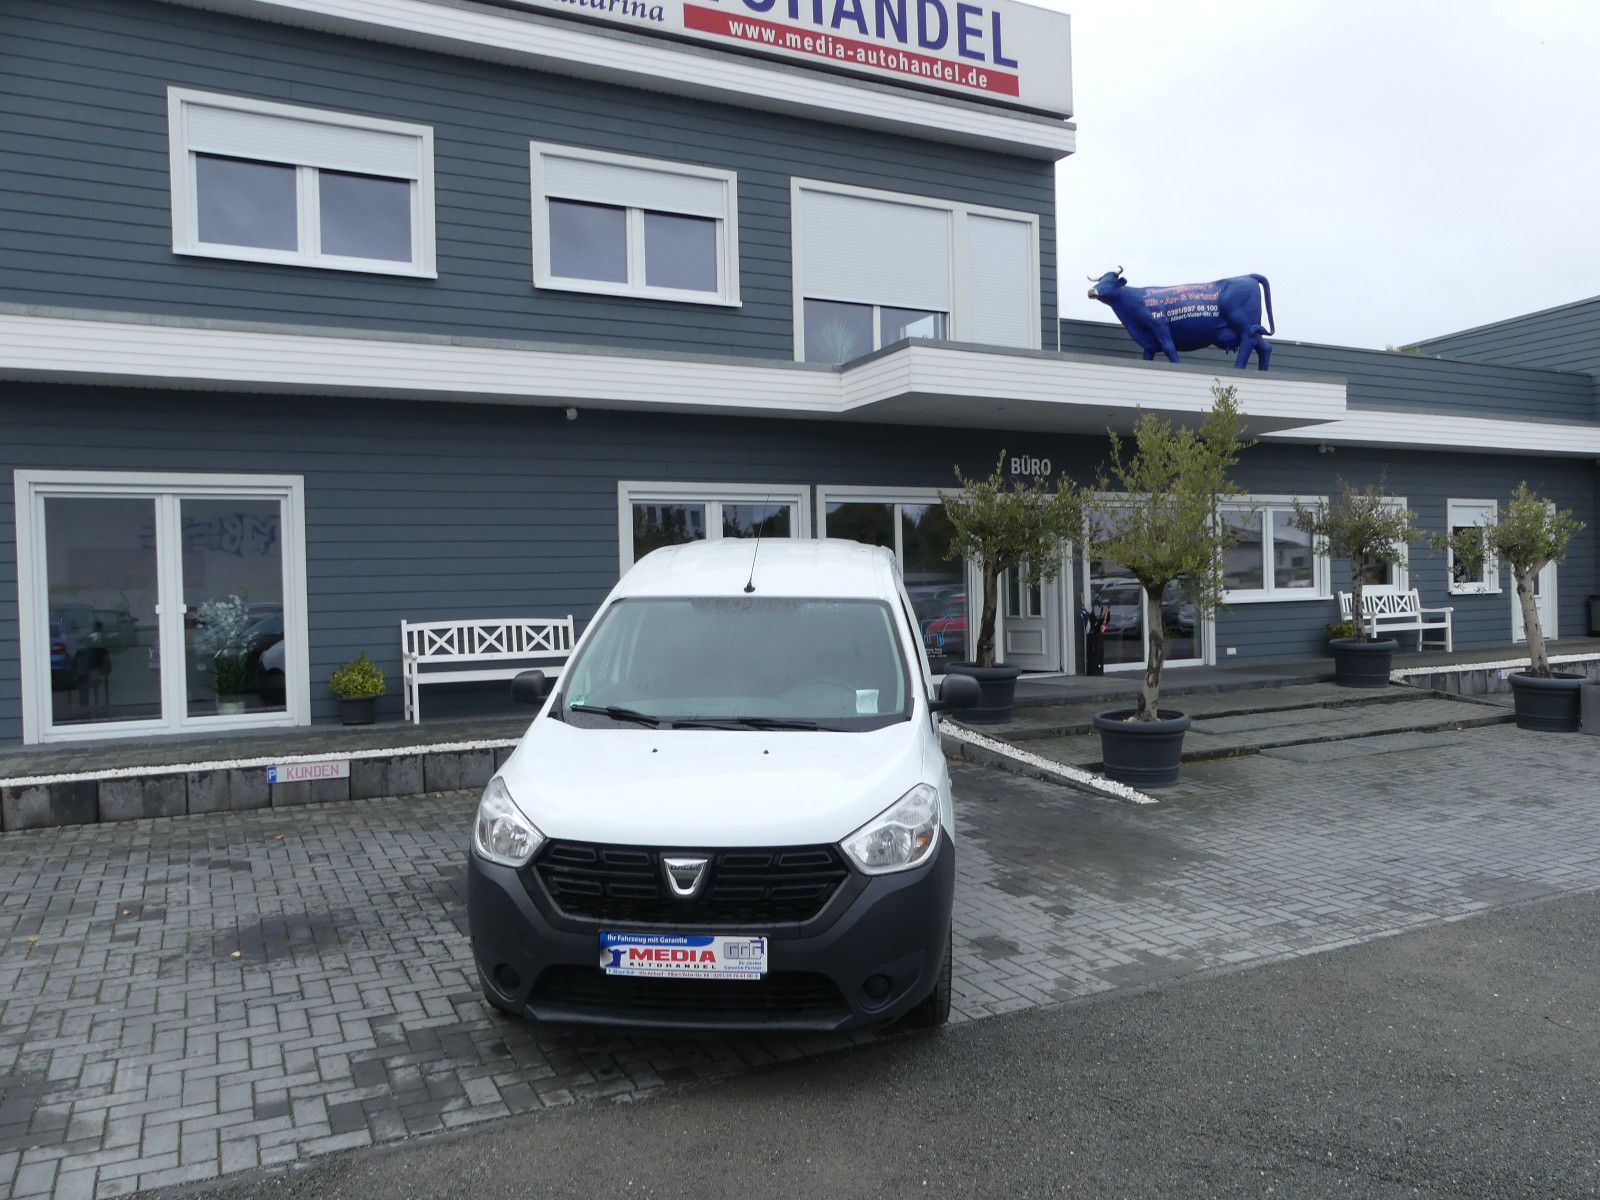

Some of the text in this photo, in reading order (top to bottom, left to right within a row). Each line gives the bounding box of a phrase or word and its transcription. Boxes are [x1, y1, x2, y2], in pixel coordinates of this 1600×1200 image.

[728, 20, 989, 88] www.media-autohandel.de
[1152, 311, 1165, 319] Tel.
[1011, 455, 1051, 475] BÜRO
[286, 764, 340, 780] KUNDEN
[618, 935, 647, 944] Fahrzeug
[659, 936, 688, 944] Garantie
[629, 948, 716, 963] MEDIA
[630, 962, 717, 970] AUTOHANDEL
